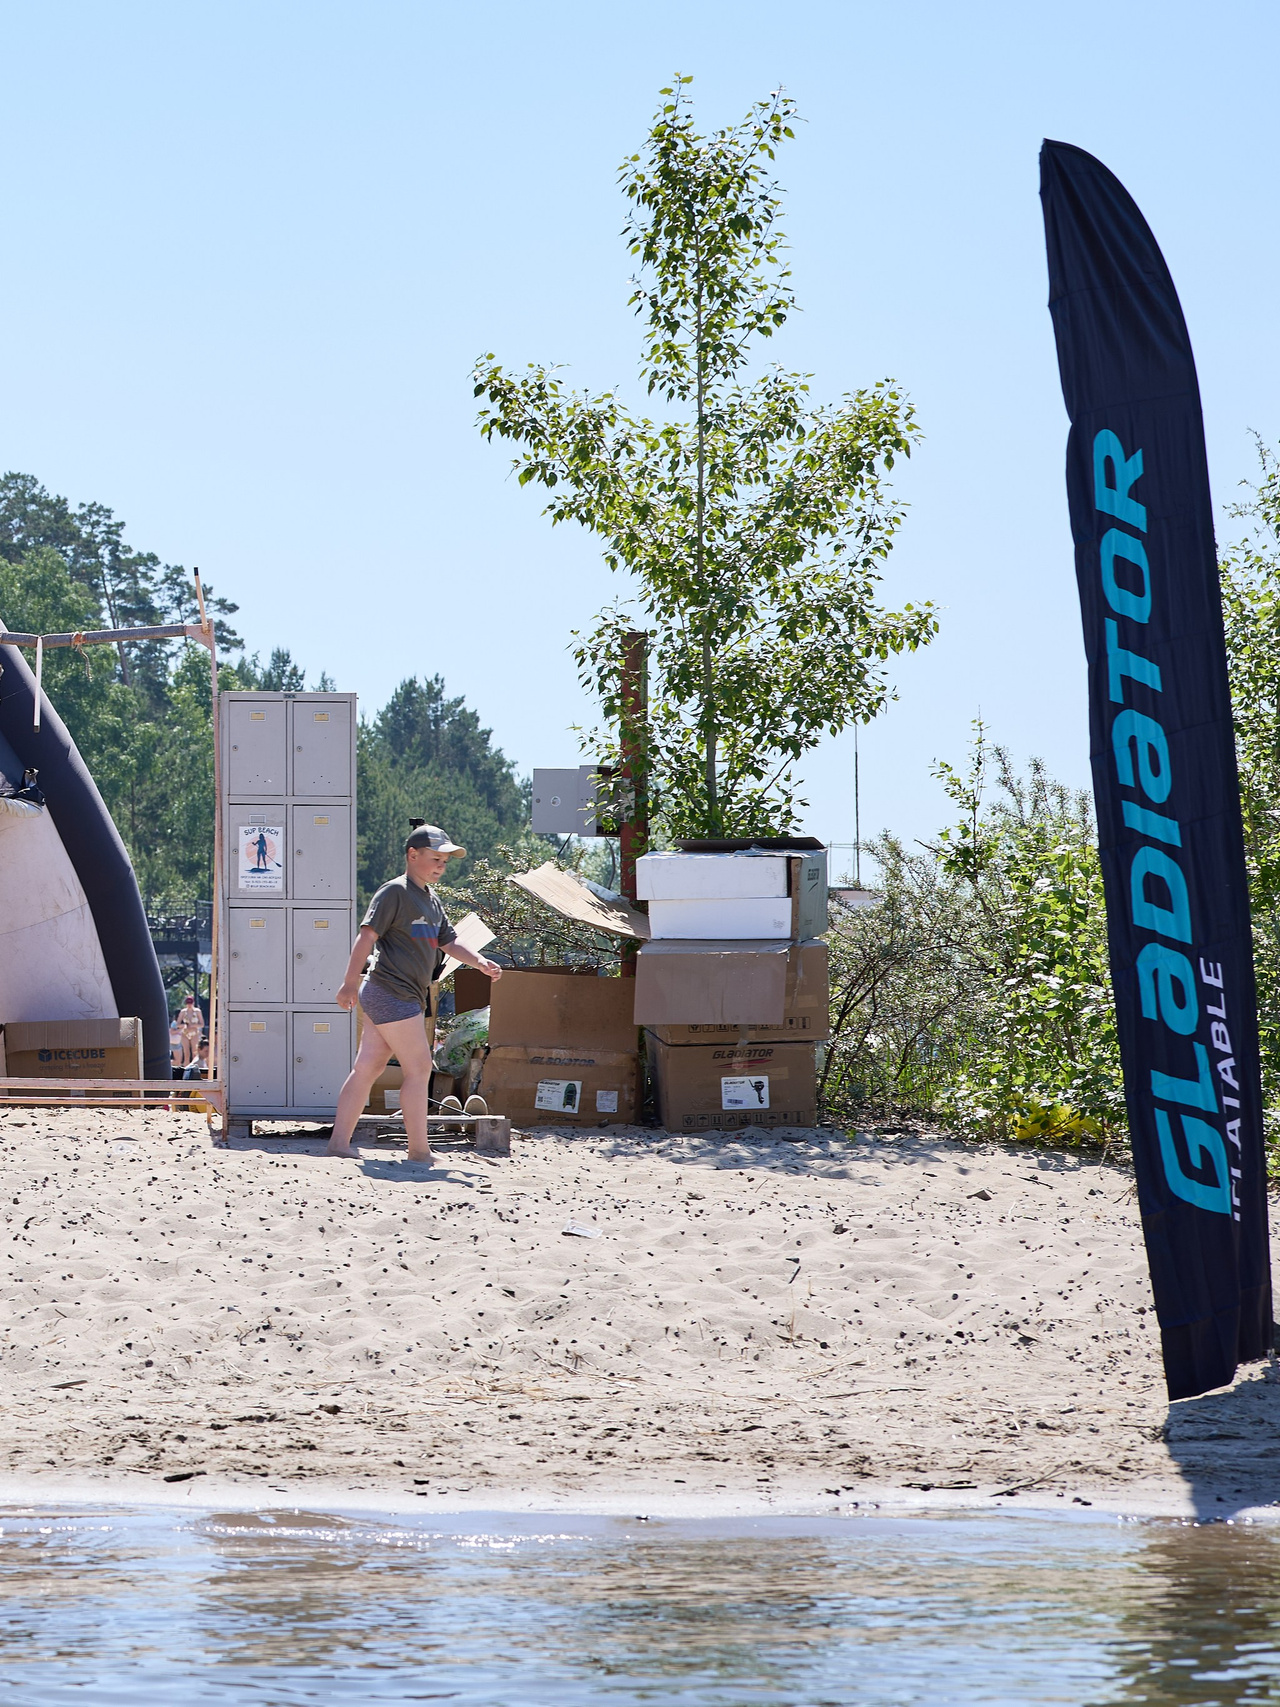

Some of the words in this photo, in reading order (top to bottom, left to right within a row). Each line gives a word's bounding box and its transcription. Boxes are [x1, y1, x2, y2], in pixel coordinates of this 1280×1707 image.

[243, 827, 256, 836] SUP
[258, 827, 279, 837] BEACH
[54, 1049, 106, 1060] ICECUBE
